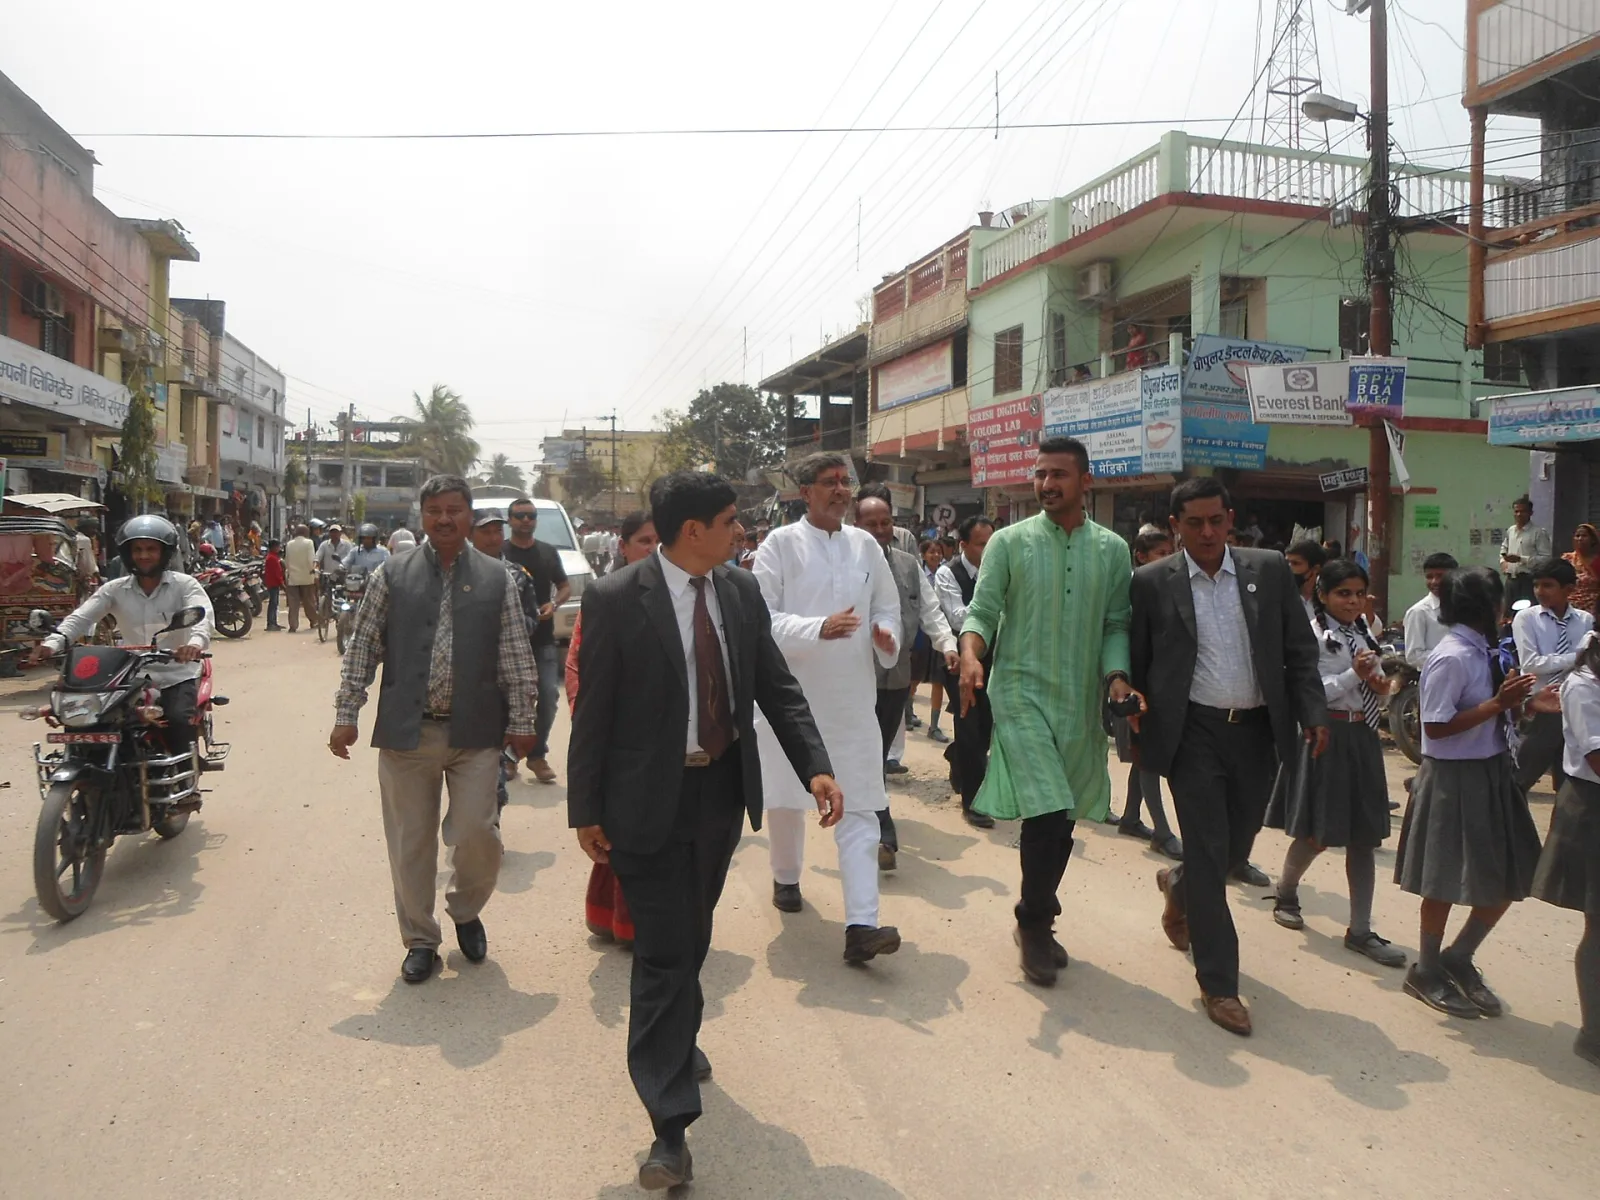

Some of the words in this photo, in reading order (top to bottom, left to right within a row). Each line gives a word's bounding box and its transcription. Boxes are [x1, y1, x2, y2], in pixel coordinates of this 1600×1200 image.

[29, 366, 74, 400] लिमिटेड
[969, 408, 995, 424] SURESH
[996, 401, 1029, 418] DIGITAL
[1256, 395, 1310, 411] Everest
[1312, 395, 1348, 411] Bank
[973, 424, 1002, 438] COLOUR
[1005, 419, 1021, 432] LAB
